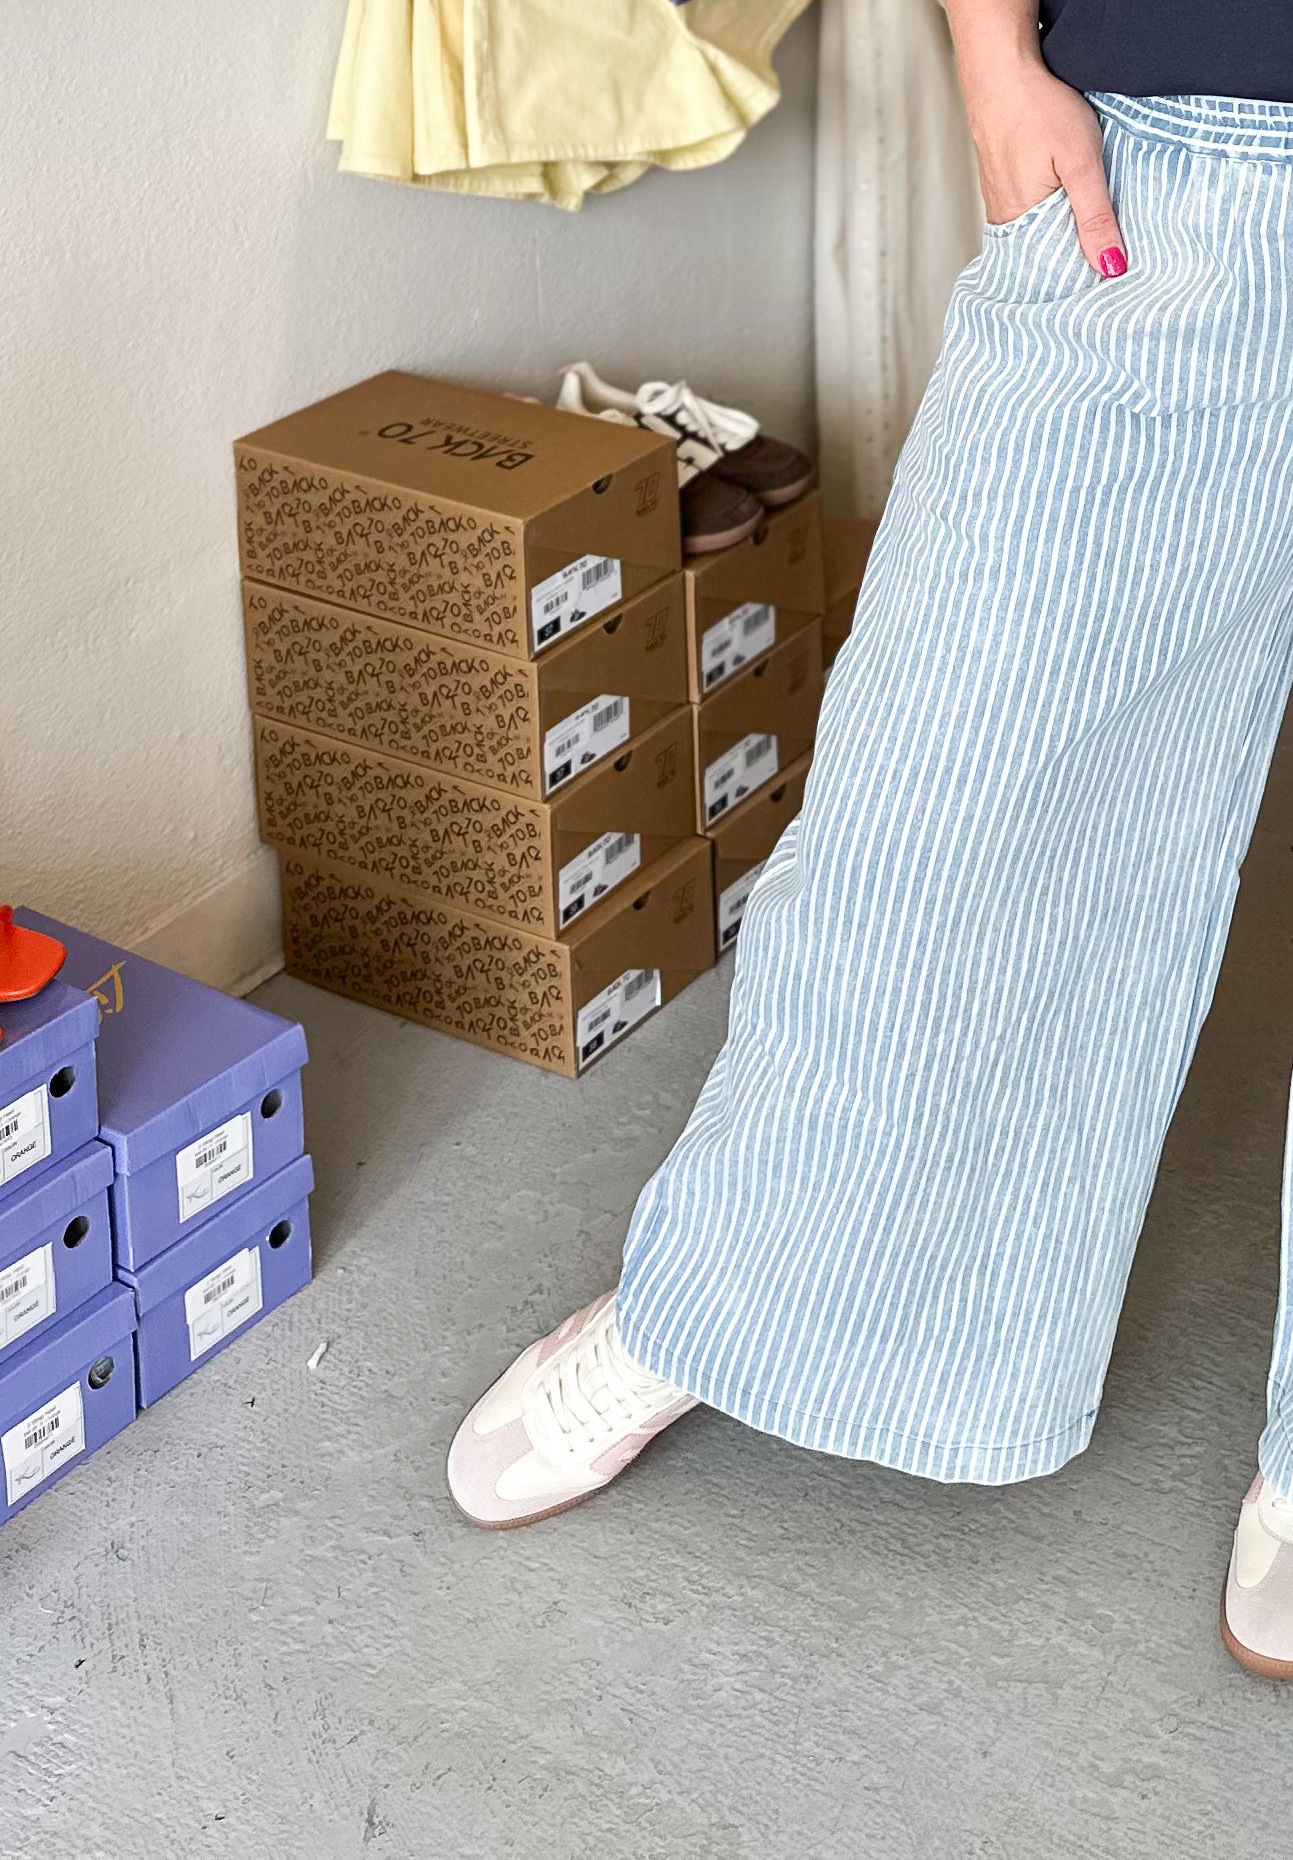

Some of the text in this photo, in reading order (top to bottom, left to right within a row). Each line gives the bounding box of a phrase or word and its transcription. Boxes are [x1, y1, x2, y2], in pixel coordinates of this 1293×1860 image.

[420, 416, 533, 450] STREETWEAR
[377, 422, 535, 471] BACK 70
[10, 1140, 37, 1162] ORANGE
[13, 1300, 39, 1323] ORANGE
[49, 1435, 75, 1461] ORANGE
